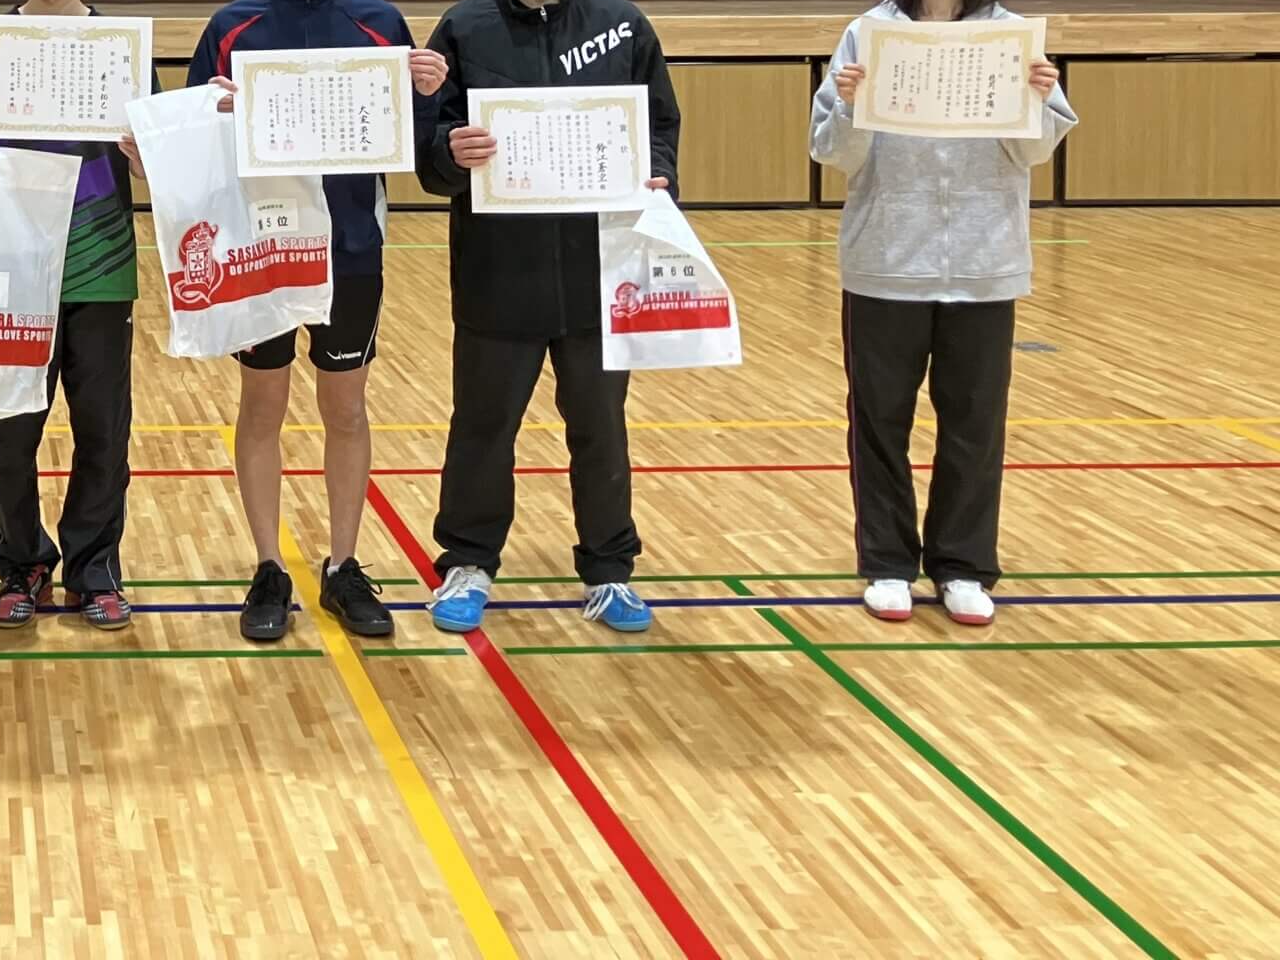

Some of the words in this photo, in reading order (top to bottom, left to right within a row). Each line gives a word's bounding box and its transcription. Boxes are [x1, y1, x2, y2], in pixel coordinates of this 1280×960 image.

[559, 21, 633, 76] VICTAS
[229, 264, 242, 276] DO
[289, 251, 326, 263] SPORTS
[0, 329, 21, 341] LOVE
